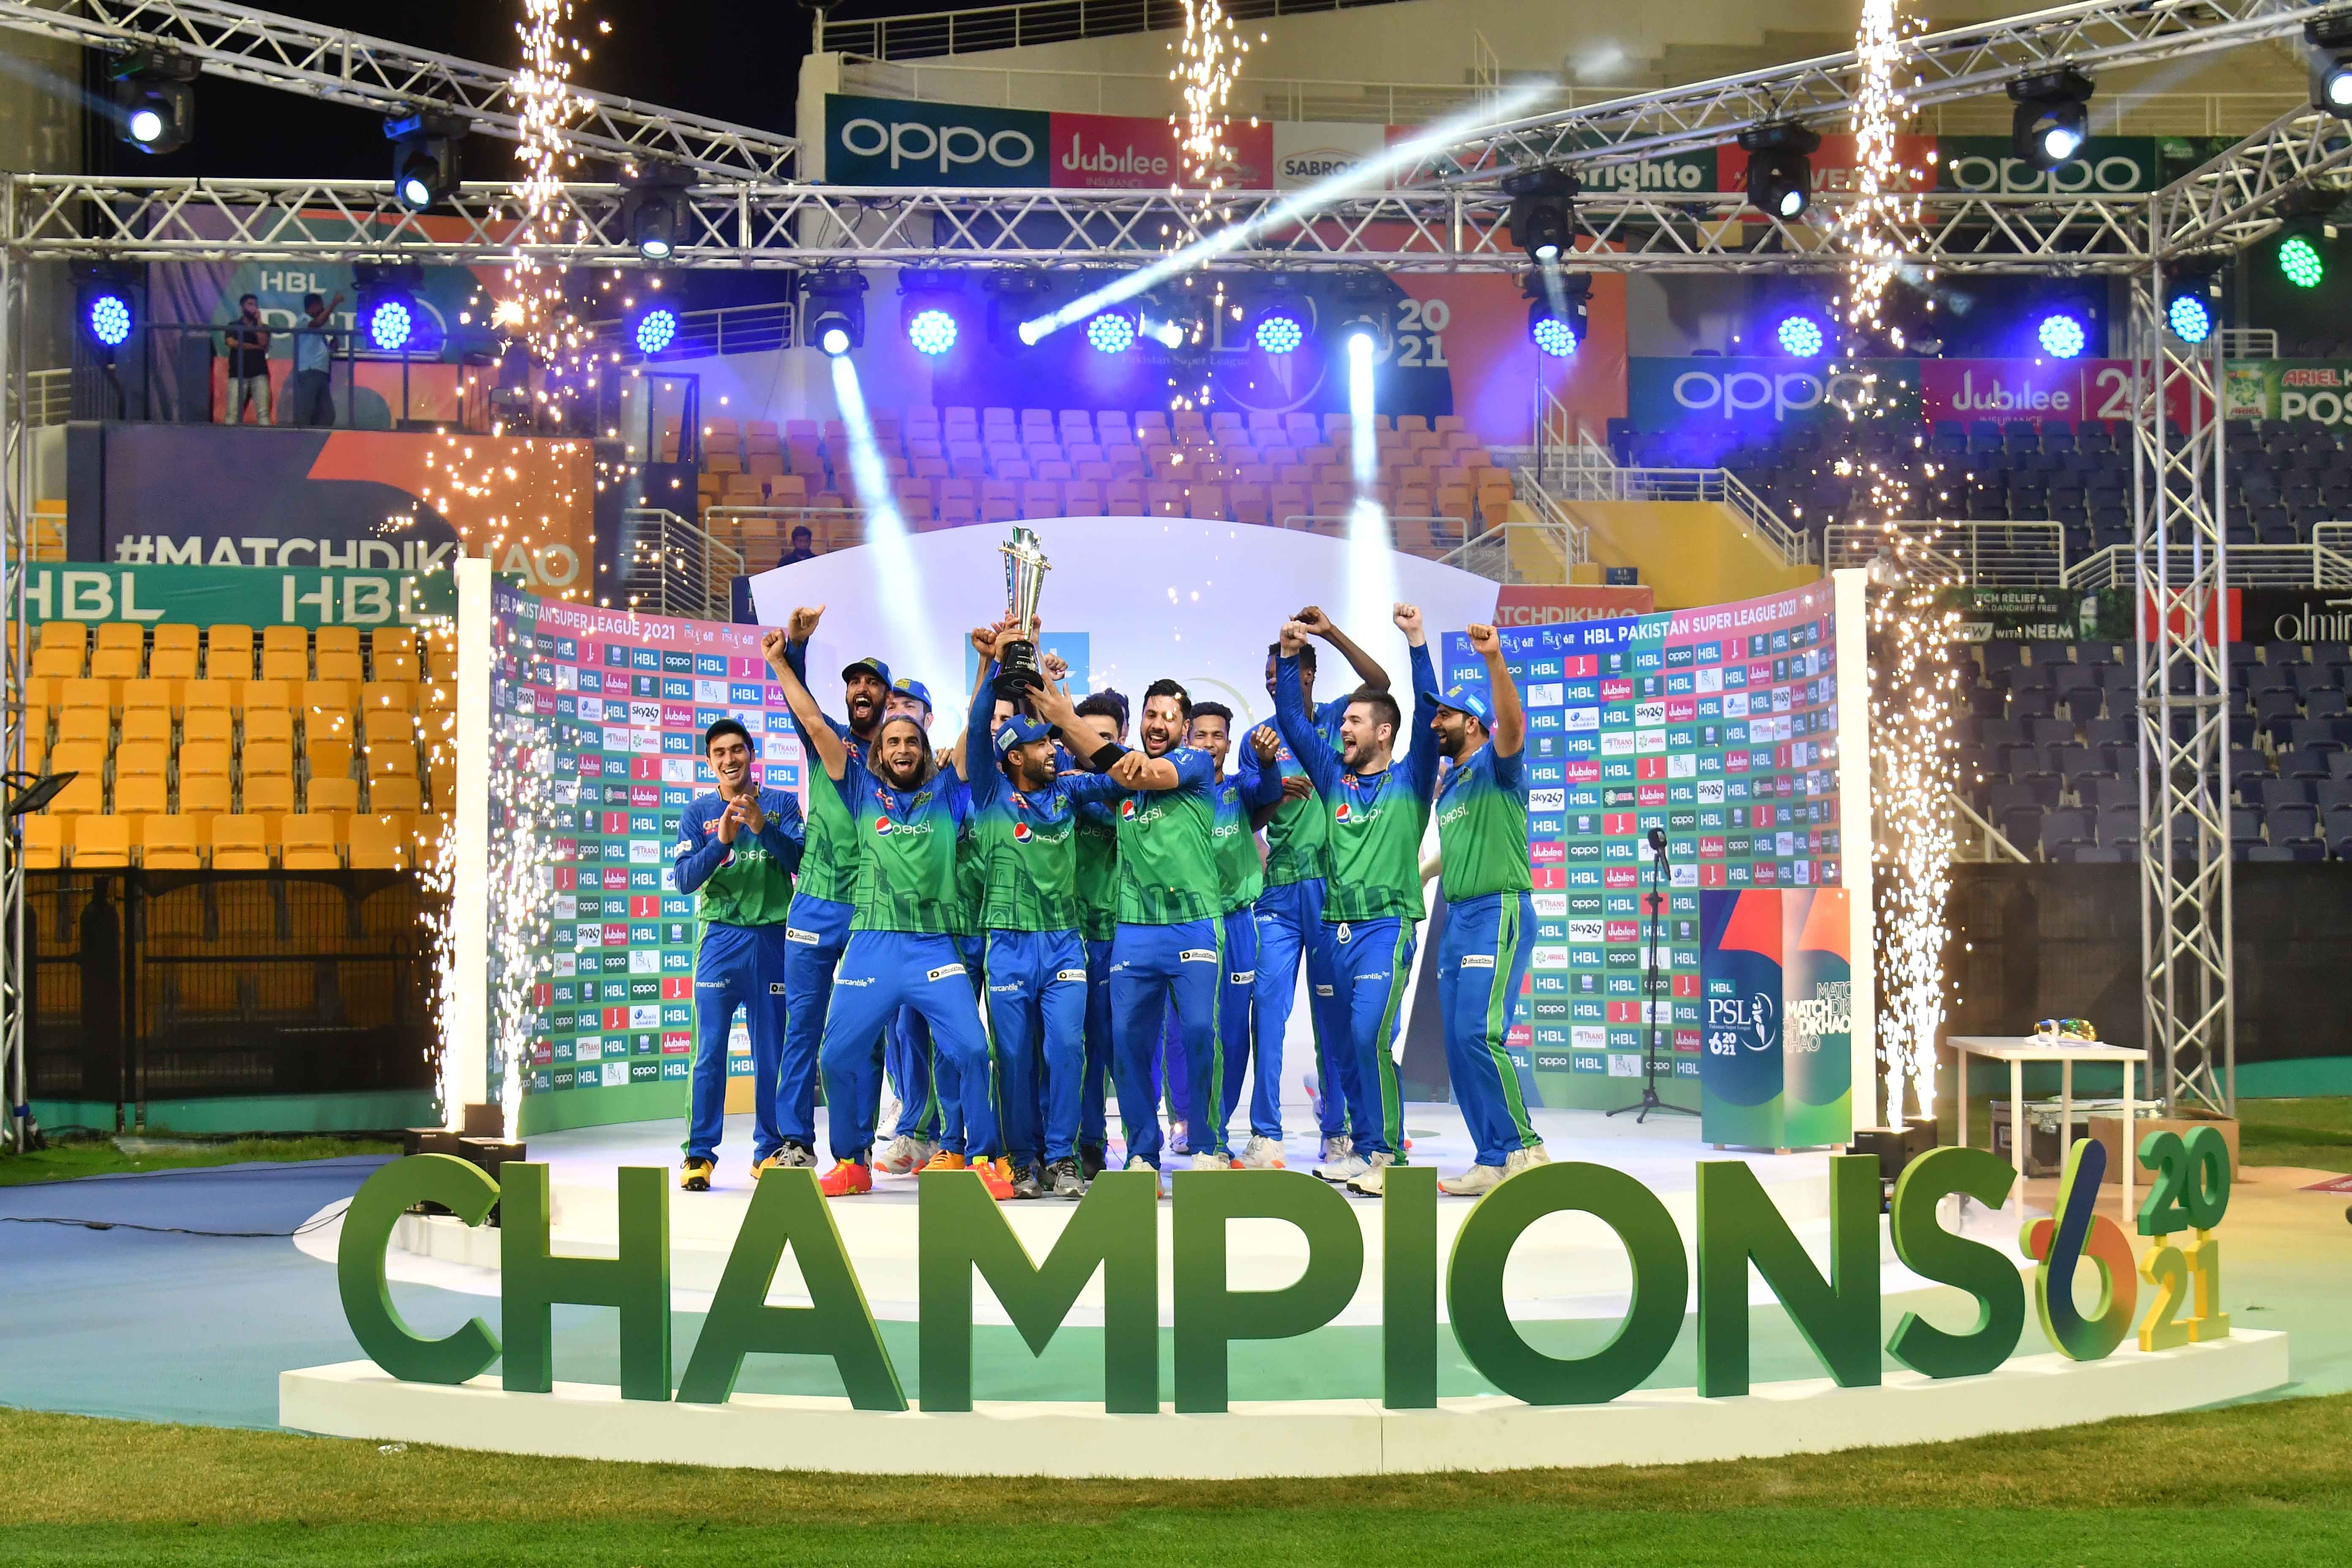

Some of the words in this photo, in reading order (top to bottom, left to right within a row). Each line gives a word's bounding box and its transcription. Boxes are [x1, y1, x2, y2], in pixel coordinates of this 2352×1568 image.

[842, 118, 1034, 173] oppo
[1062, 132, 1167, 174] Jubilee
[1285, 160, 1358, 176] SABRO
[1954, 157, 2141, 193] oppo
[1086, 177, 1143, 187] INSURANCE
[261, 270, 326, 293] HBL
[1398, 299, 1449, 331] 20
[1398, 335, 1448, 366] 21
[1211, 356, 1250, 367] League
[2283, 369, 2341, 386] ARIEL
[1673, 370, 1875, 419] oppo
[1952, 370, 2069, 411] Jubilee
[2230, 407, 2262, 415] ARIEL
[6, 572, 165, 621] HBL
[282, 575, 441, 623] HBL
[2002, 593, 2036, 603] RELIEF
[2039, 595, 2045, 603] &
[554, 609, 587, 629] SUPER
[591, 614, 640, 636] LEAGUE
[644, 622, 675, 640] 2021
[1584, 627, 1614, 644] HBL
[1619, 618, 1689, 641] PAKISTAN
[1693, 613, 1731, 632] SUPER
[1734, 606, 1776, 626] LEAGUE
[1778, 599, 1796, 617] 2021
[1995, 630, 2021, 638] WITH
[2025, 624, 2073, 639] NEEM
[1668, 651, 1691, 662] oppo
[1698, 645, 1718, 659] HBL
[634, 653, 657, 666] HBL
[665, 656, 690, 667] oppo
[698, 659, 724, 671] HBL
[1454, 669, 1482, 680] HBL
[1531, 663, 1558, 675] HBL
[605, 674, 628, 690] Jubilee
[665, 683, 689, 696] HBL
[732, 689, 759, 700] HBL
[1568, 686, 1595, 699] HBL
[1602, 683, 1630, 695] Jubilee
[665, 707, 690, 721] Jubilee
[1669, 703, 1692, 717] Jubilee
[768, 717, 794, 728] HBL
[665, 737, 689, 749] HBL
[1569, 739, 1596, 751] HBL
[1569, 764, 1597, 776] Jubilee
[1699, 757, 1720, 770] HBL
[768, 769, 795, 781] HBL
[632, 788, 657, 801] Jubilee
[664, 791, 689, 804] HBL
[1639, 787, 1665, 800] Jubilee
[1440, 803, 1467, 828] pepsi
[1672, 816, 1694, 826] oppo
[1533, 820, 1561, 832] HBL
[580, 845, 599, 855] oppo
[640, 848, 659, 856] TRANS
[1533, 844, 1563, 857] Jubilee
[1571, 846, 1598, 855] oppo
[1607, 845, 1633, 857] HBL
[579, 872, 599, 885] HBL
[604, 871, 627, 884] Jubilee
[632, 873, 656, 886] HBL
[1607, 869, 1634, 882] Jubilee
[579, 901, 599, 911] oppo
[1571, 899, 1599, 909] oppo
[1673, 898, 1695, 909] HBL
[604, 927, 627, 939] Jubilee
[1608, 923, 1636, 936] Jubilee
[605, 957, 626, 966] oppo
[1573, 952, 1600, 963] HBL
[1609, 953, 1636, 962] oppo
[604, 984, 625, 996] HBL
[633, 984, 656, 994] oppo
[696, 980, 726, 988] mercantile
[1711, 983, 1732, 993] HBL
[1537, 1004, 1565, 1013] oppo
[1675, 1007, 1697, 1019] HBL
[1708, 999, 1751, 1024] PSL
[1785, 999, 1832, 1018] MATCH
[664, 1009, 688, 1022] HBL
[664, 1037, 690, 1048] Jubilee
[1610, 1033, 1636, 1044] HBL
[1676, 1032, 1699, 1045] Jubilee
[1709, 1032, 1722, 1055] 6
[1723, 1032, 1736, 1043] 20
[1723, 1044, 1736, 1055] 21
[1539, 1057, 1566, 1066] oppo
[633, 1065, 656, 1076] oppo
[2137, 1126, 2231, 1236] 20
[2019, 1138, 2137, 1361] 6
[338, 1146, 2025, 1414] CHAMPIONS
[2138, 1239, 2230, 1352] 21
